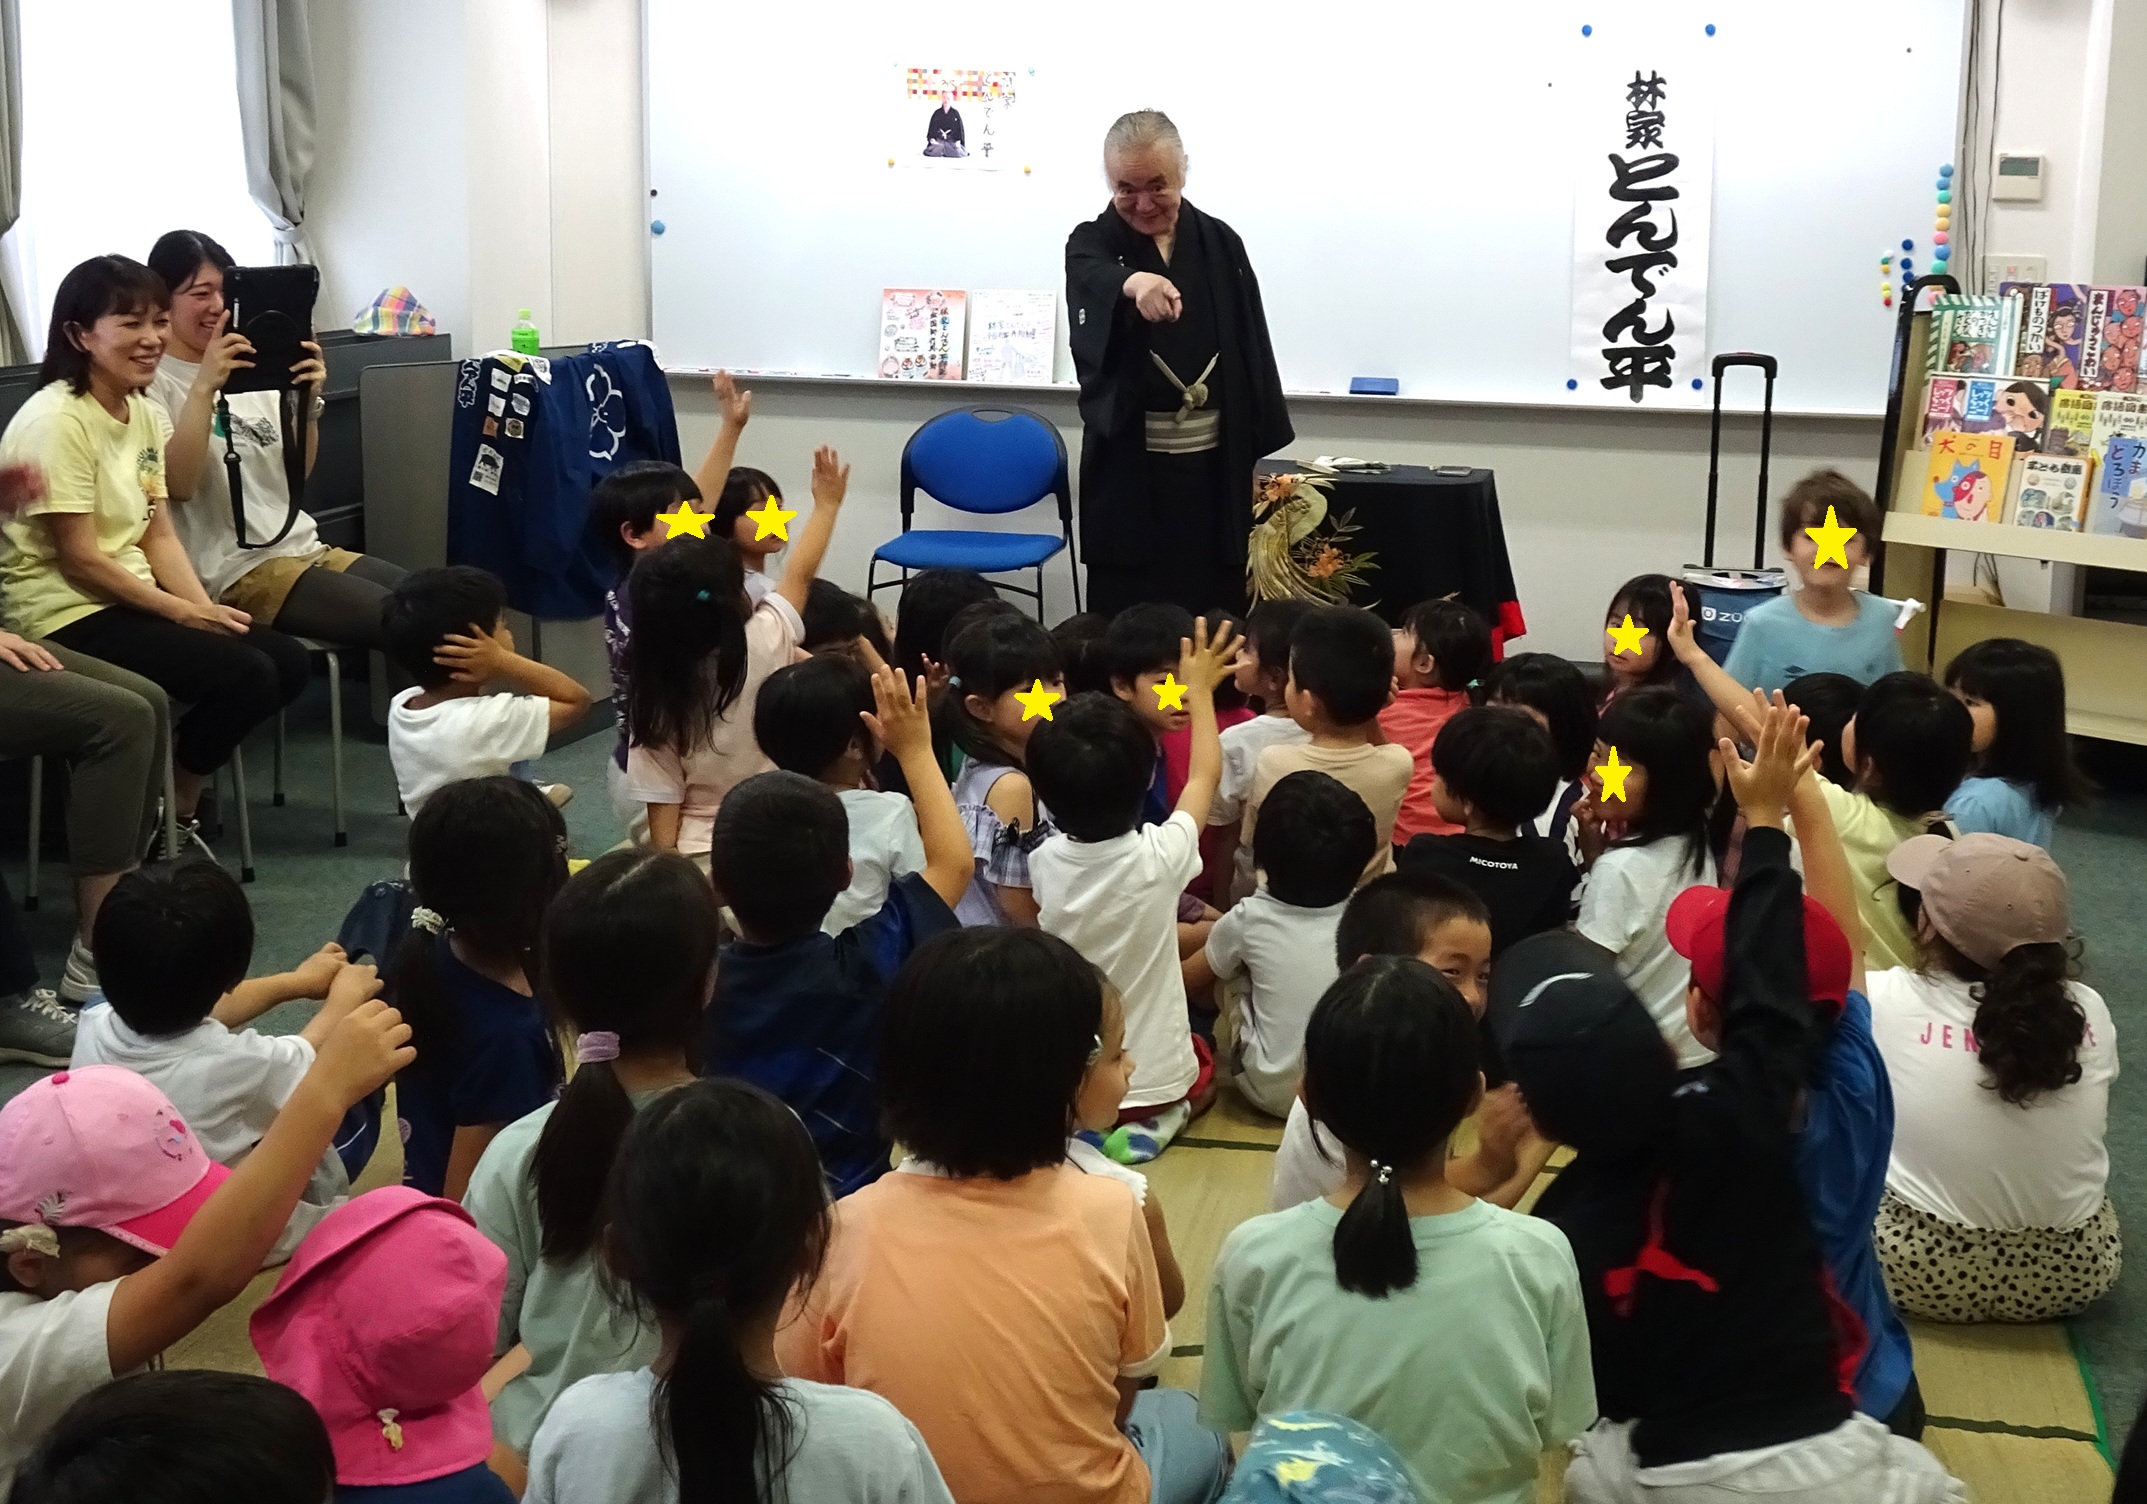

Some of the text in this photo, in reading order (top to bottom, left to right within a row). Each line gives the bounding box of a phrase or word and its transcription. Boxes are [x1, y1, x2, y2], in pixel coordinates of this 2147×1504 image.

[1600, 70, 1680, 403] 林家とんでん平
[2029, 290, 2048, 351] ばけものつかい
[2083, 292, 2105, 376] まんじゅうこわい
[1938, 435, 2003, 460] 犬の目
[1469, 856, 1519, 870] MICOTOYA
